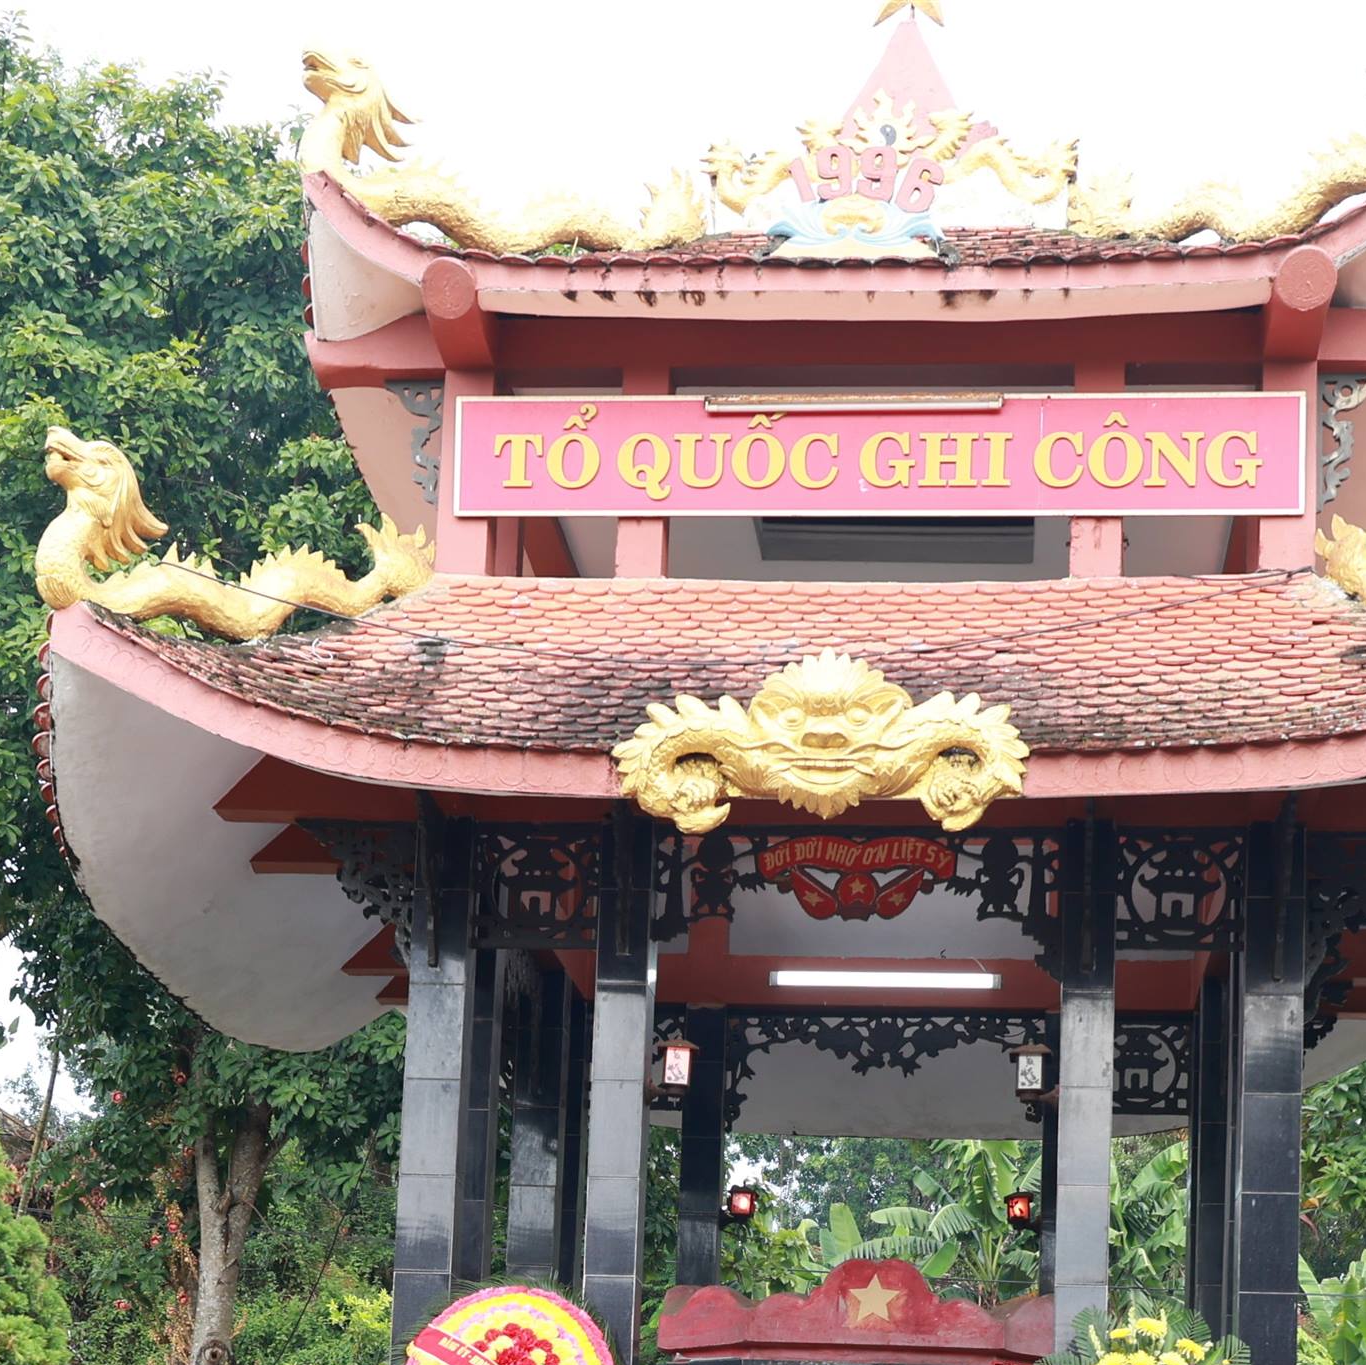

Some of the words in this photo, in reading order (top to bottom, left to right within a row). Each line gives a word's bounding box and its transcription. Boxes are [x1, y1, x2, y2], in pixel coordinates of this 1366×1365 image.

[787, 145, 945, 213] 1996
[493, 403, 601, 489] TỔ
[616, 412, 840, 501] QUỐC
[858, 431, 1014, 489] GHI
[1033, 410, 1264, 489] CÔNG
[825, 842, 862, 867] NHỚ
[891, 838, 925, 862] LIỆT
